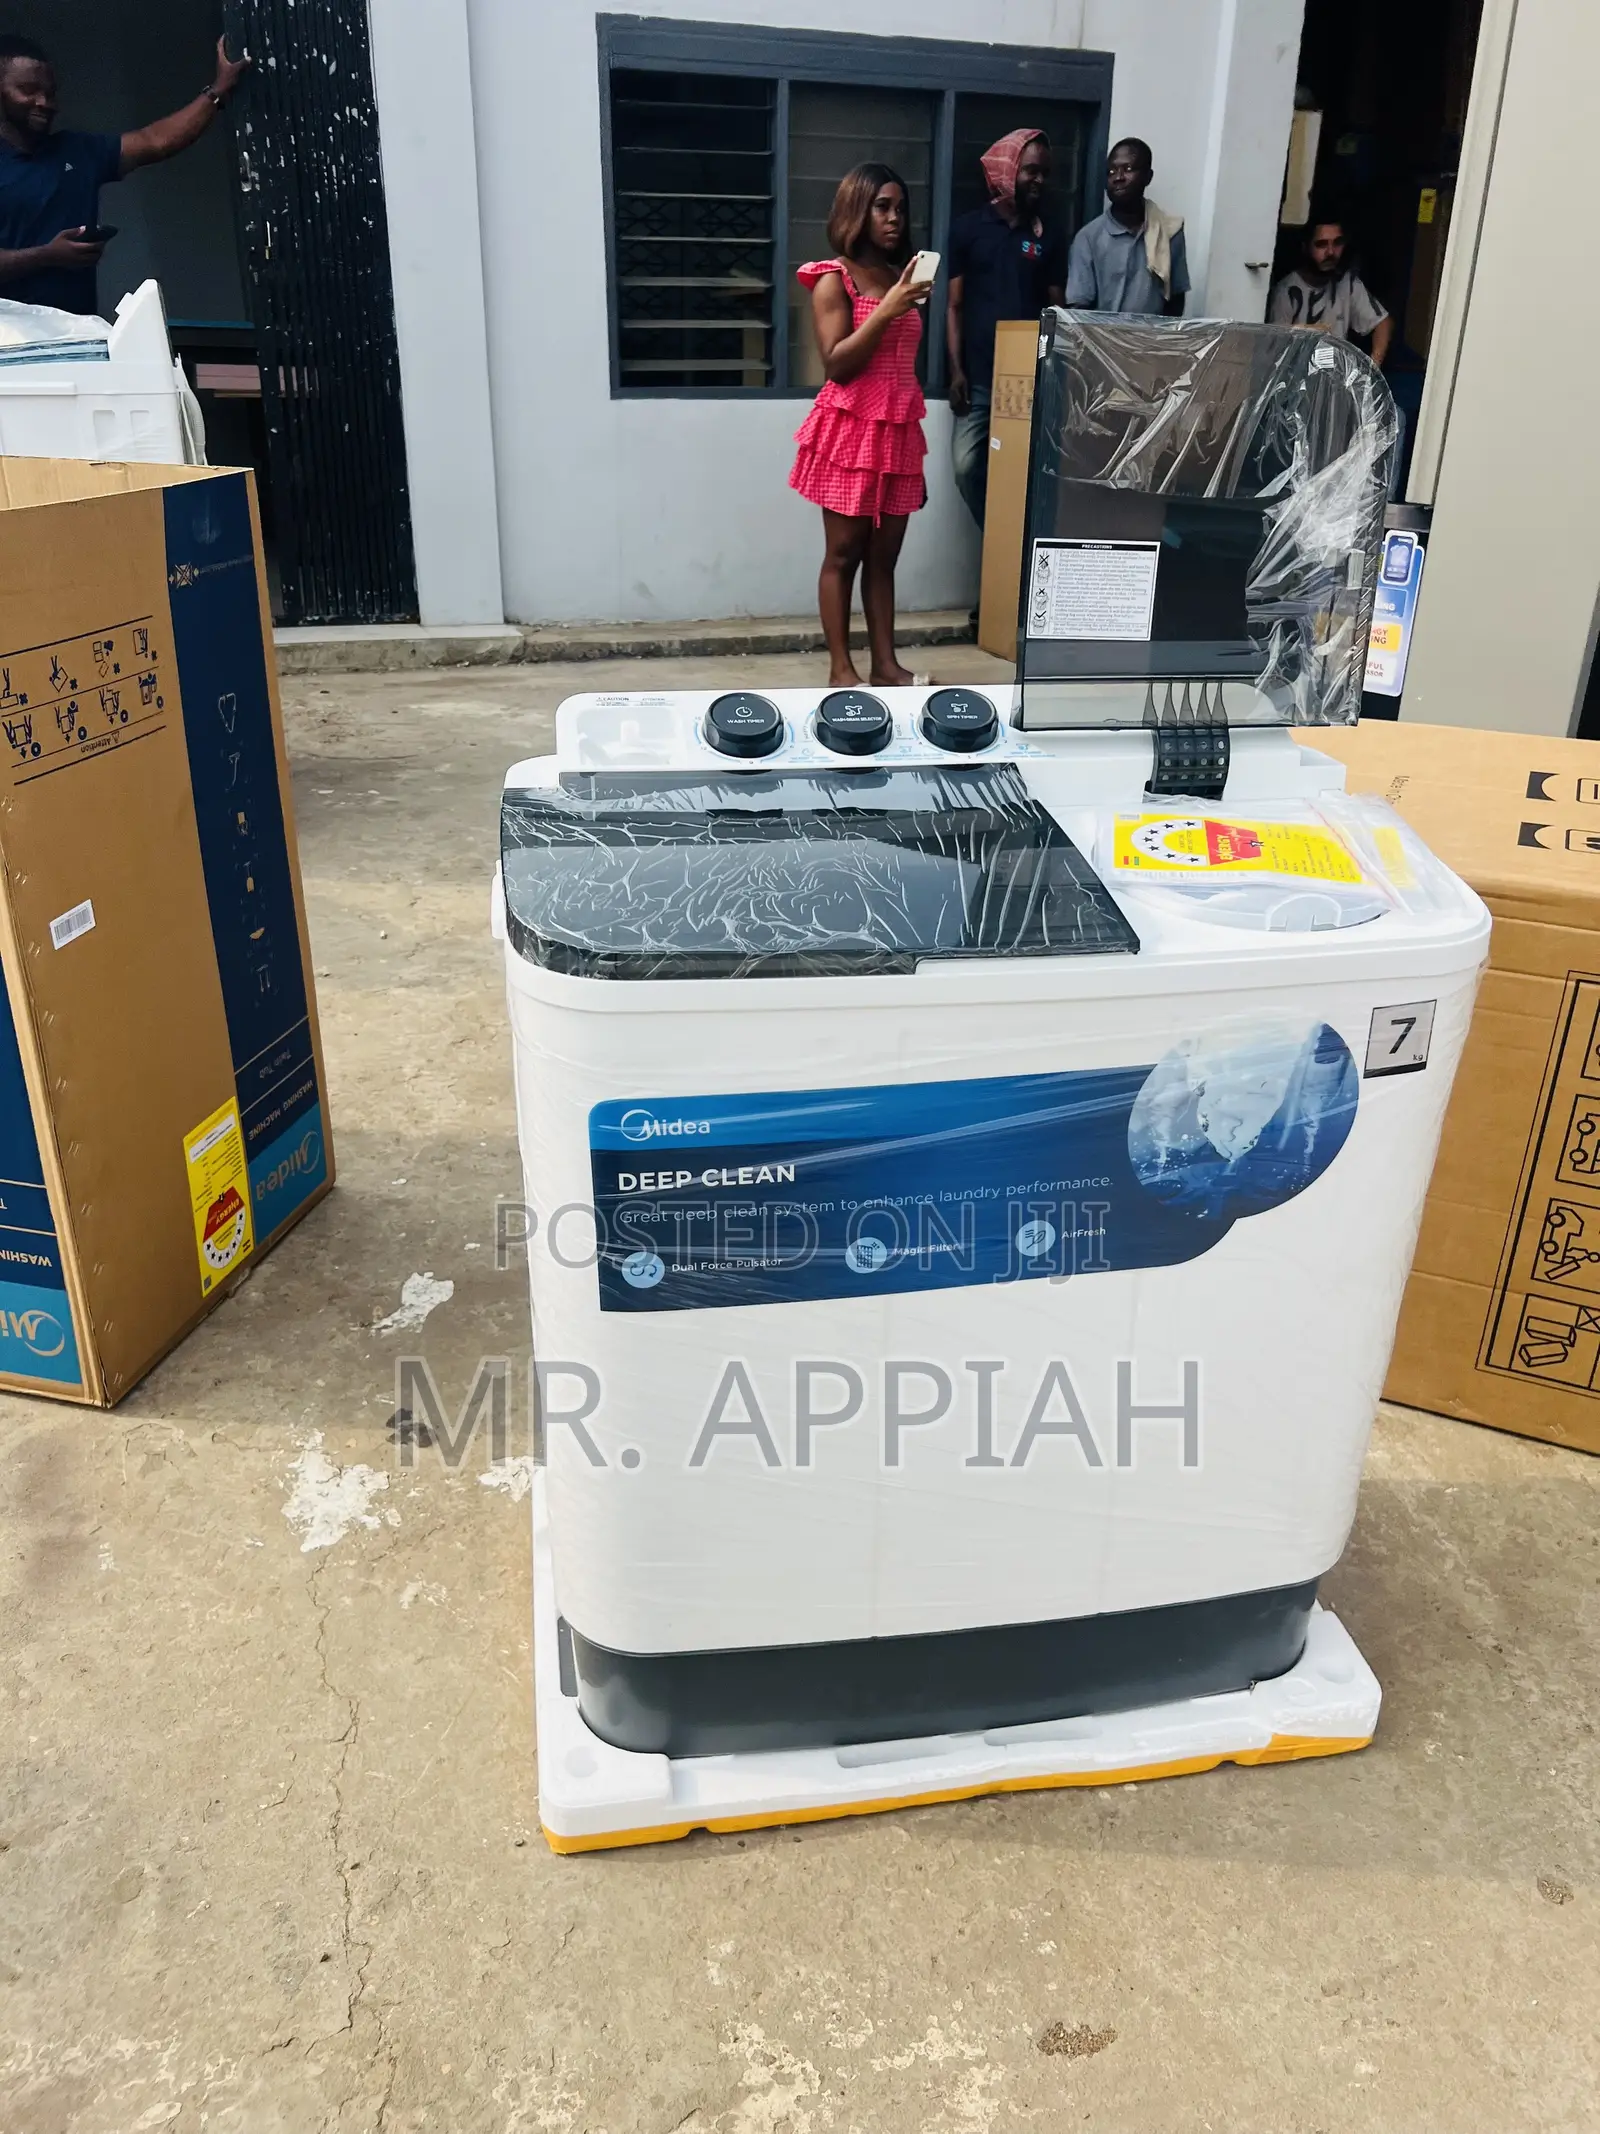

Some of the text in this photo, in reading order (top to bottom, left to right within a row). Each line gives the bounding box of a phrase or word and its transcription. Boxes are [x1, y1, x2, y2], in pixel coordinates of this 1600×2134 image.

[80, 734, 109, 753] Attention
[1216, 834, 1234, 861] ENERGY
[1390, 1017, 1417, 1054] 7
[259, 1048, 292, 1079] Twin Tub
[1412, 1053, 1424, 1062] kg
[248, 1079, 314, 1141] WASHING MACHINE
[621, 1109, 711, 1141] Midea
[256, 1130, 320, 1201] Midea
[618, 1164, 796, 1191] DEEP CLEAN
[216, 1197, 241, 1226] ENERGY
[619, 1175, 1114, 1224] Great deep clean system to enhance laundry performance.
[1061, 1227, 1106, 1239] AirFresh
[893, 1242, 961, 1257] Magic Filter
[672, 1259, 783, 1273] Dual Force Pulsator
